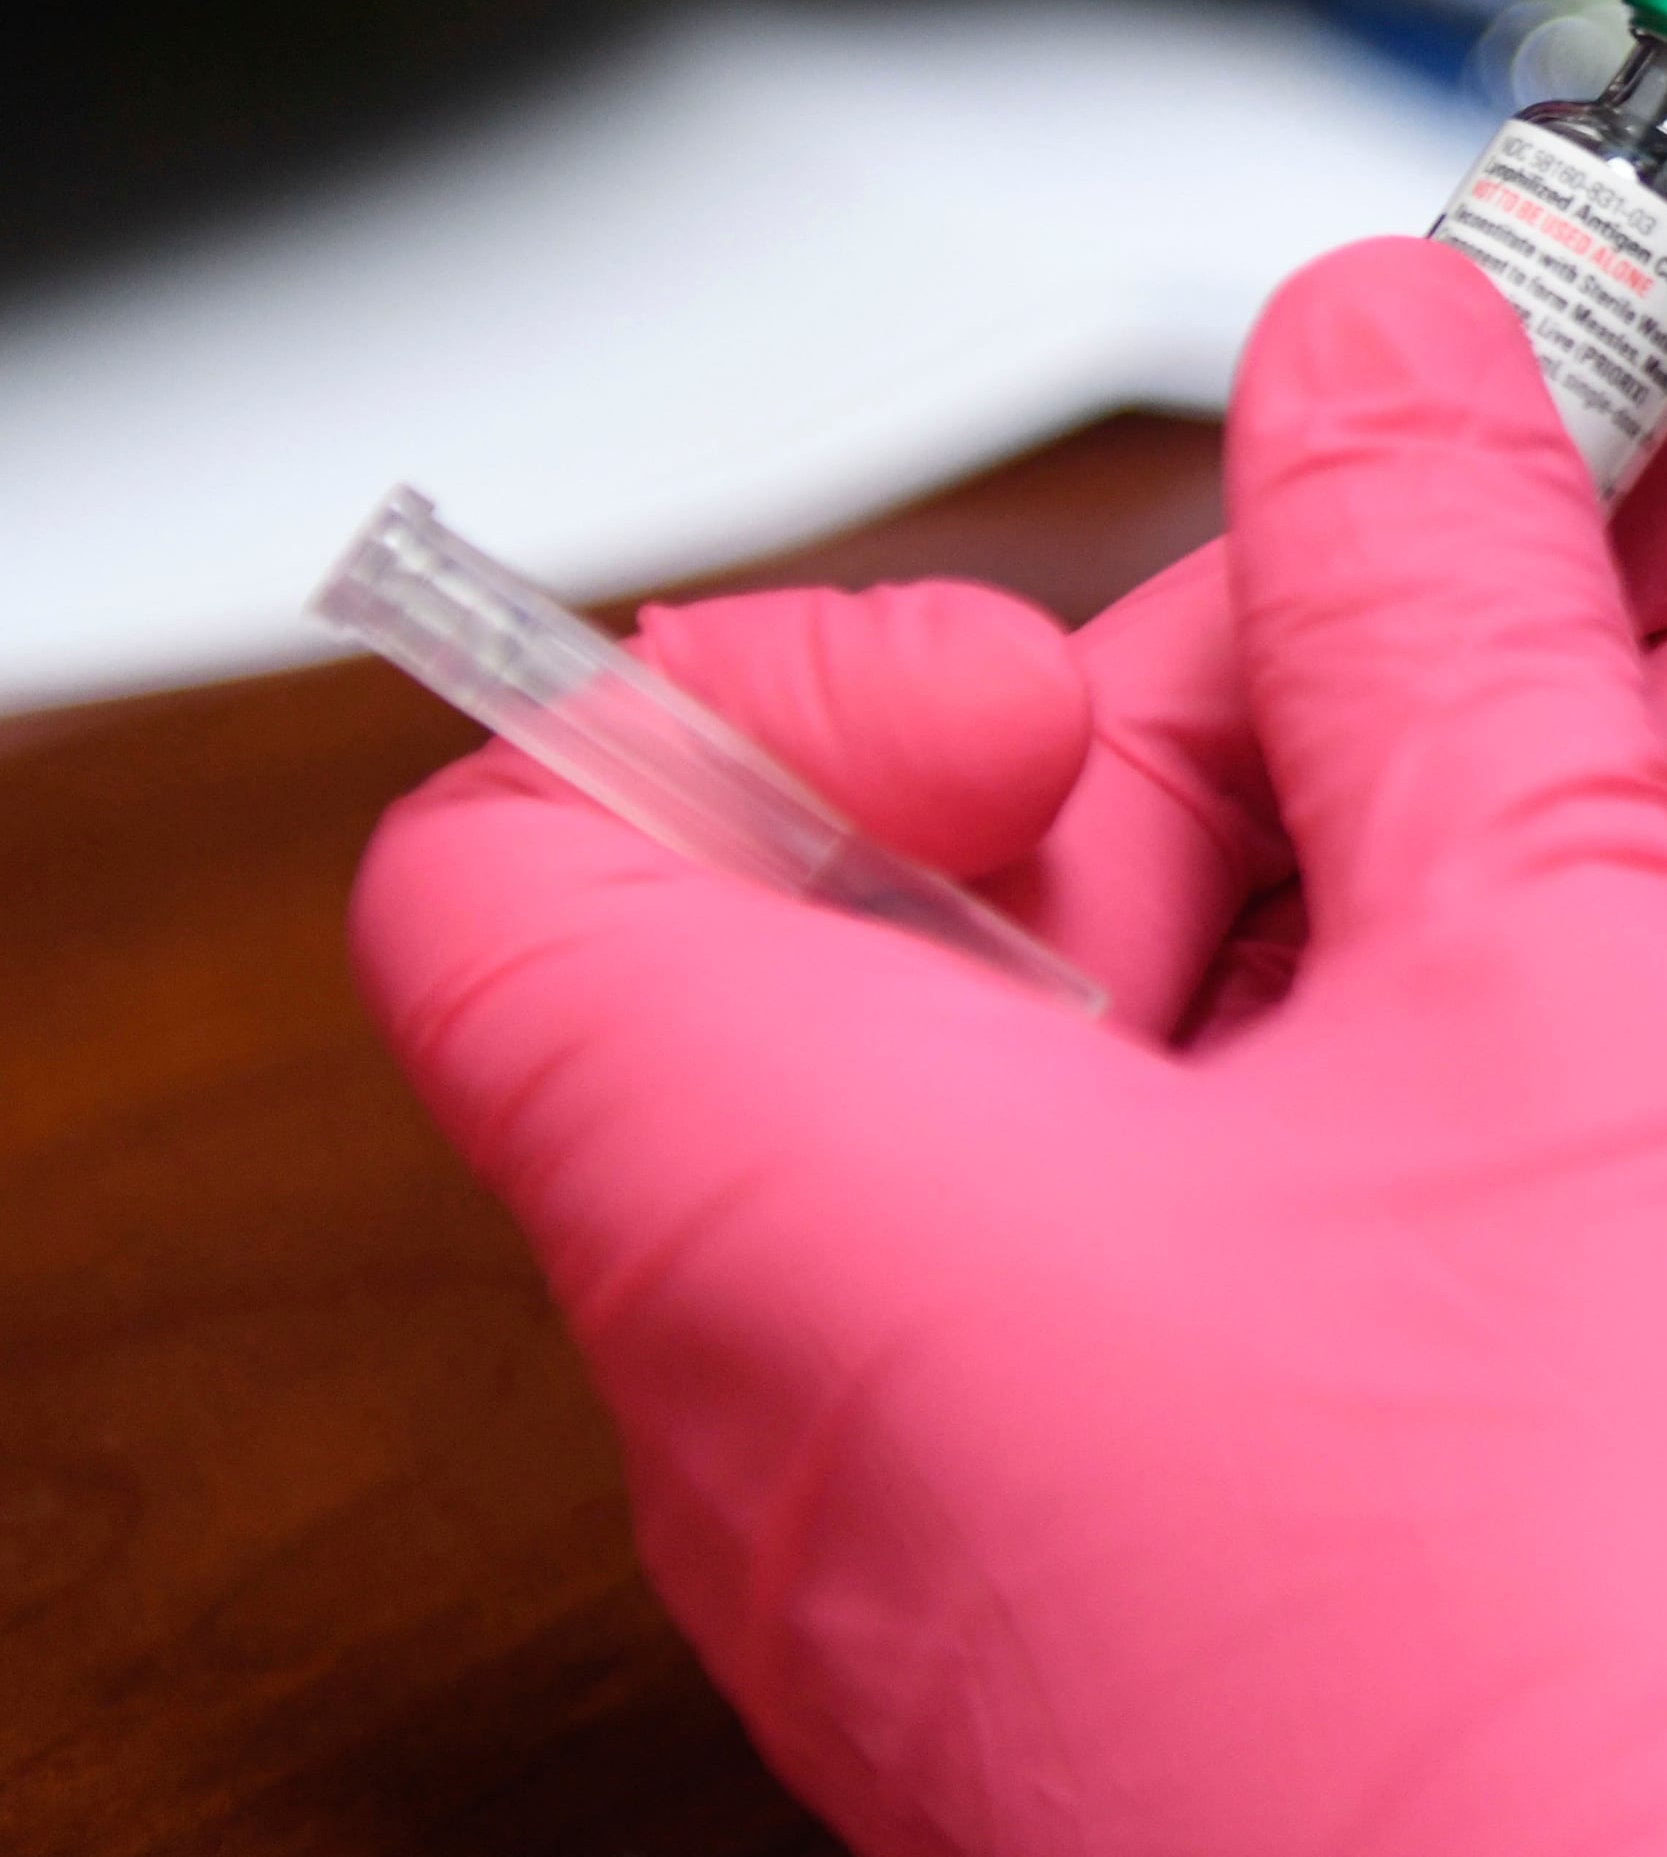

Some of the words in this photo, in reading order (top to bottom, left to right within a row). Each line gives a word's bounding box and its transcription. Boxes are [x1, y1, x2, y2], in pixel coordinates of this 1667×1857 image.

[1515, 199, 1544, 226] BE
[1540, 212, 1593, 256] USED
[1590, 245, 1655, 300] ALONE
[1575, 204, 1651, 263] Antigen
[1539, 252, 1577, 285] with
[1579, 274, 1635, 326] Sterile
